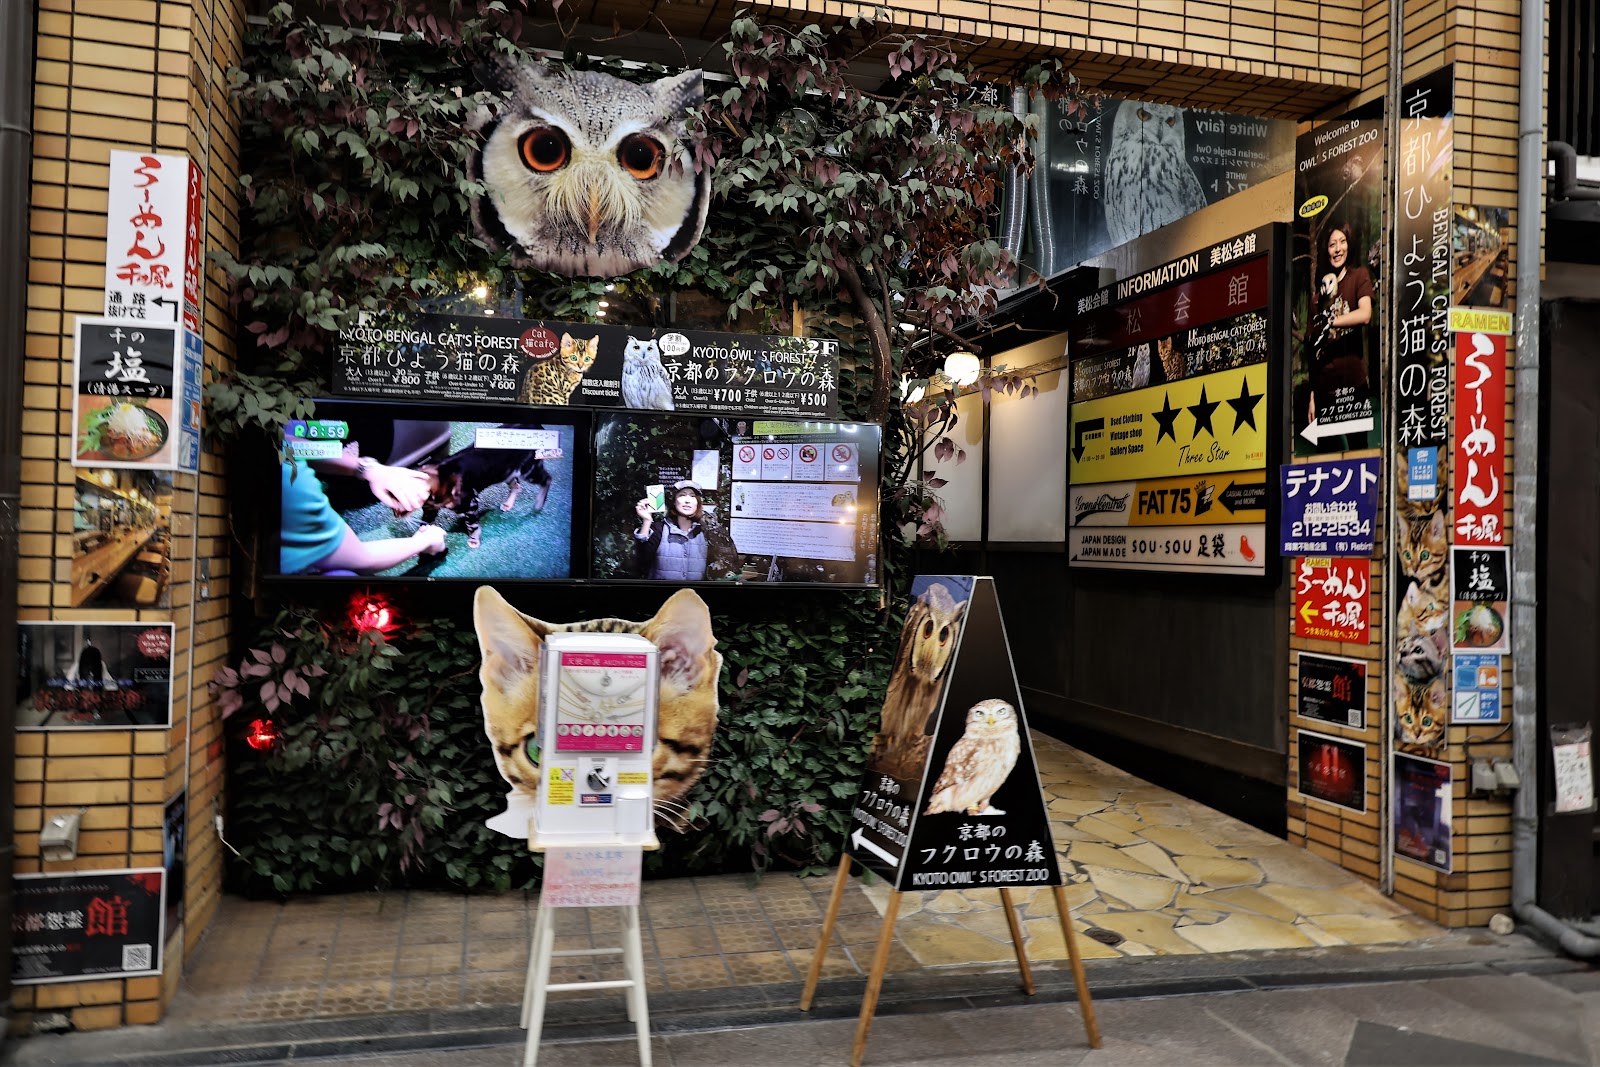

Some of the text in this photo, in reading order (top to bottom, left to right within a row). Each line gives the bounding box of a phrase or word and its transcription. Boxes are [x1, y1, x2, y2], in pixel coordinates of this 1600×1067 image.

[1314, 119, 1360, 147] Welcome to
[1328, 137, 1358, 160] FOREST
[1358, 128, 1378, 146] ZOO
[1209, 232, 1257, 268] 美松会館
[1116, 253, 1200, 300] INFORMATION
[1398, 88, 1433, 448] 京都ひょう猫の森
[1430, 207, 1449, 441] BENGAL CAT'S FOREST
[1450, 310, 1510, 332] RAMEN
[385, 329, 436, 345] BENGAL
[438, 332, 473, 347] CAT'S
[474, 335, 521, 350] FOREST
[531, 328, 547, 339] Cat
[1206, 329, 1230, 344] BENGAL
[1230, 325, 1243, 338] CAT
[1243, 318, 1268, 334] FOREST
[692, 346, 729, 360] KYOTO
[769, 351, 808, 364] FOREST
[806, 340, 839, 355] 2F
[104, 345, 151, 384] 塩
[338, 343, 520, 375] 京都ひょう猫の森
[345, 366, 364, 377] 大人
[395, 367, 407, 376] 30
[423, 370, 441, 381] 子供
[492, 373, 504, 382] 30
[664, 358, 836, 392] 京都のフクロウの森
[489, 380, 516, 391] ¥600
[581, 387, 620, 397] Discount ticket
[673, 385, 689, 396] 大人
[743, 388, 758, 398] 子供
[713, 388, 742, 403] ¥700
[800, 392, 828, 407] ¥500
[1320, 398, 1373, 417] フクロウの森
[1110, 412, 1143, 427] Used Clothing
[1458, 332, 1500, 508] らーめん
[310, 426, 346, 439] 6:59
[1109, 428, 1143, 441] Vintage shop
[1109, 444, 1144, 456] Gallery Space
[1178, 440, 1231, 468] Three Star
[1285, 461, 1378, 498] テナント
[1225, 488, 1266, 498] CASUAL CLOTHING
[1243, 497, 1257, 505] MORE
[1304, 500, 1358, 514] お問い合わせ
[1291, 519, 1372, 538] 212-2534
[1081, 535, 1127, 545] JAPAN DESIGN
[1081, 547, 1127, 557] JAPAN MADE
[1305, 558, 1331, 567] RAMEN
[1297, 561, 1367, 600] らーめん
[1468, 563, 1496, 591] 塩
[957, 823, 1007, 841] 京都の
[920, 839, 1046, 865] フクロウの森
[912, 872, 948, 886] KYOTO
[988, 868, 1026, 883] FOREST
[1025, 867, 1050, 882] ZOO
